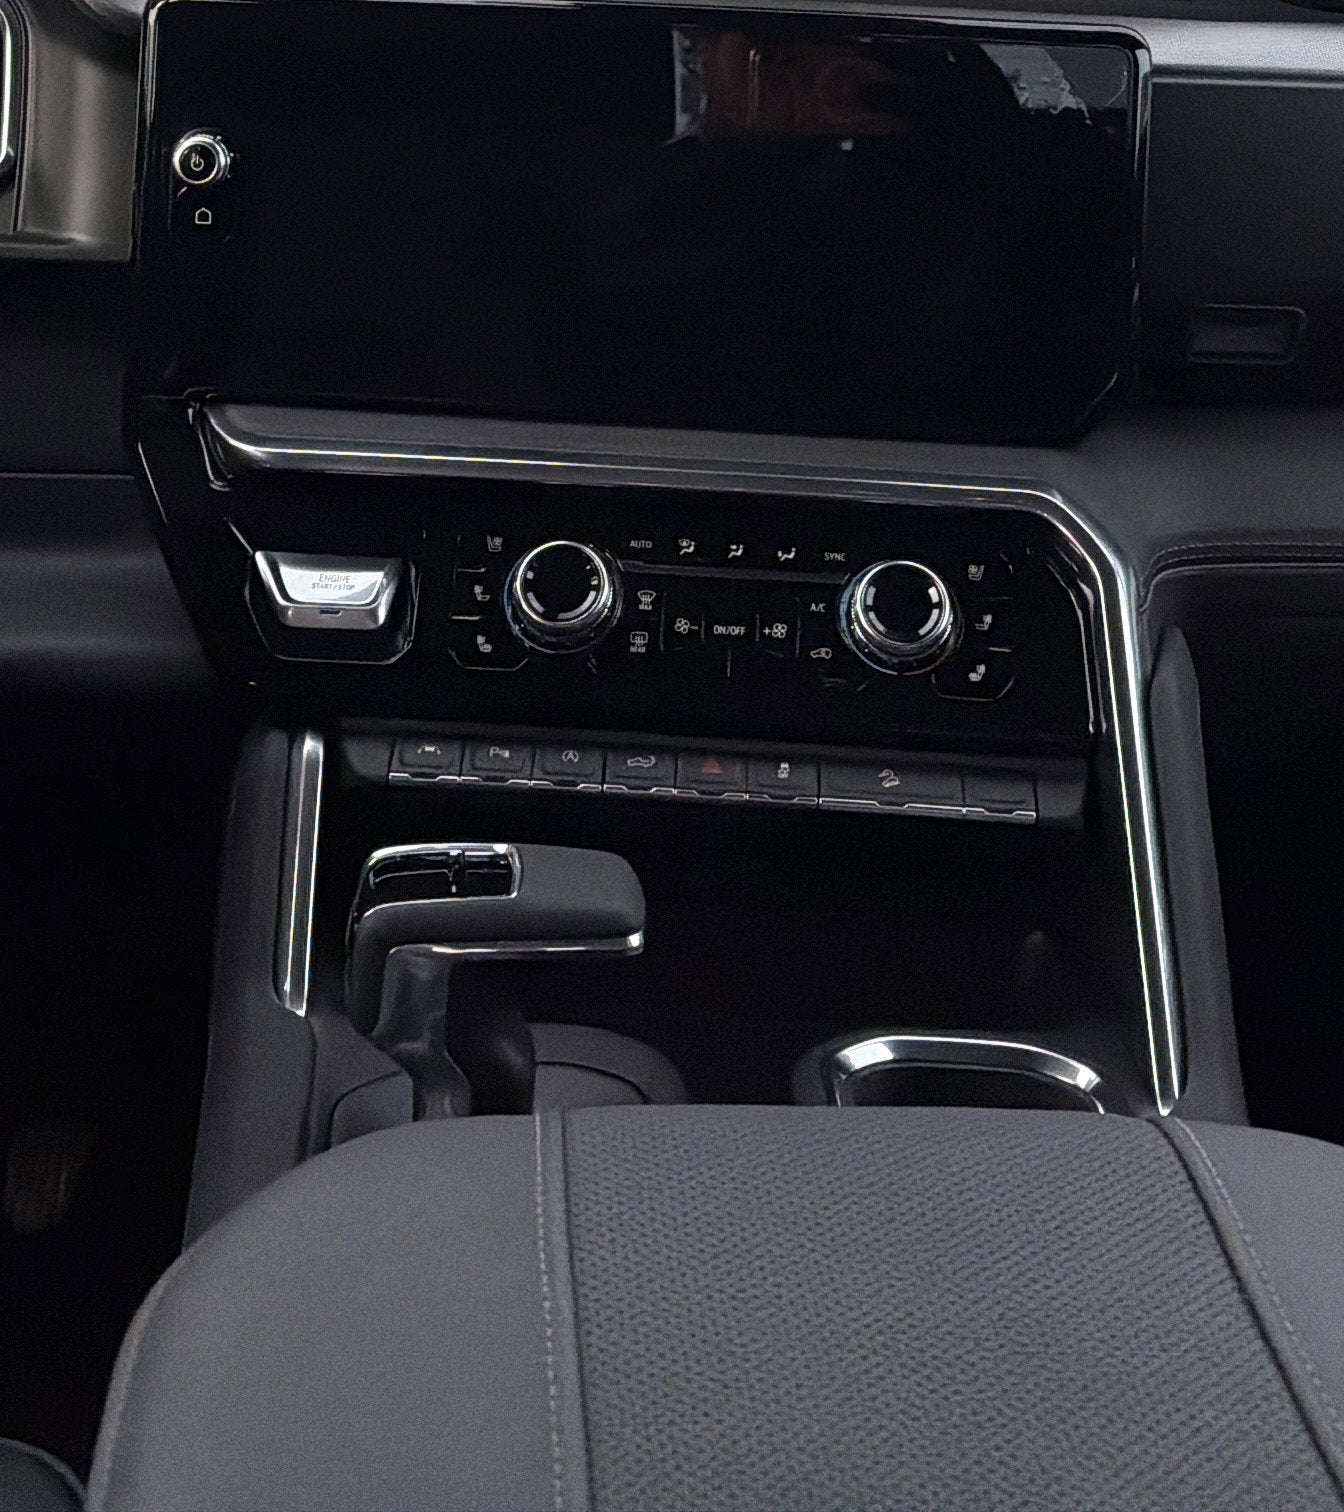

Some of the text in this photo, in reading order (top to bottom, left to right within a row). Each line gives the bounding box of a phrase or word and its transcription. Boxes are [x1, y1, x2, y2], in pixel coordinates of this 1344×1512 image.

[629, 539, 653, 549] AUTO
[824, 551, 847, 562] SYNC
[318, 573, 351, 584] ENGINE
[809, 603, 826, 613] A/C
[713, 624, 746, 636] ON/OFF
